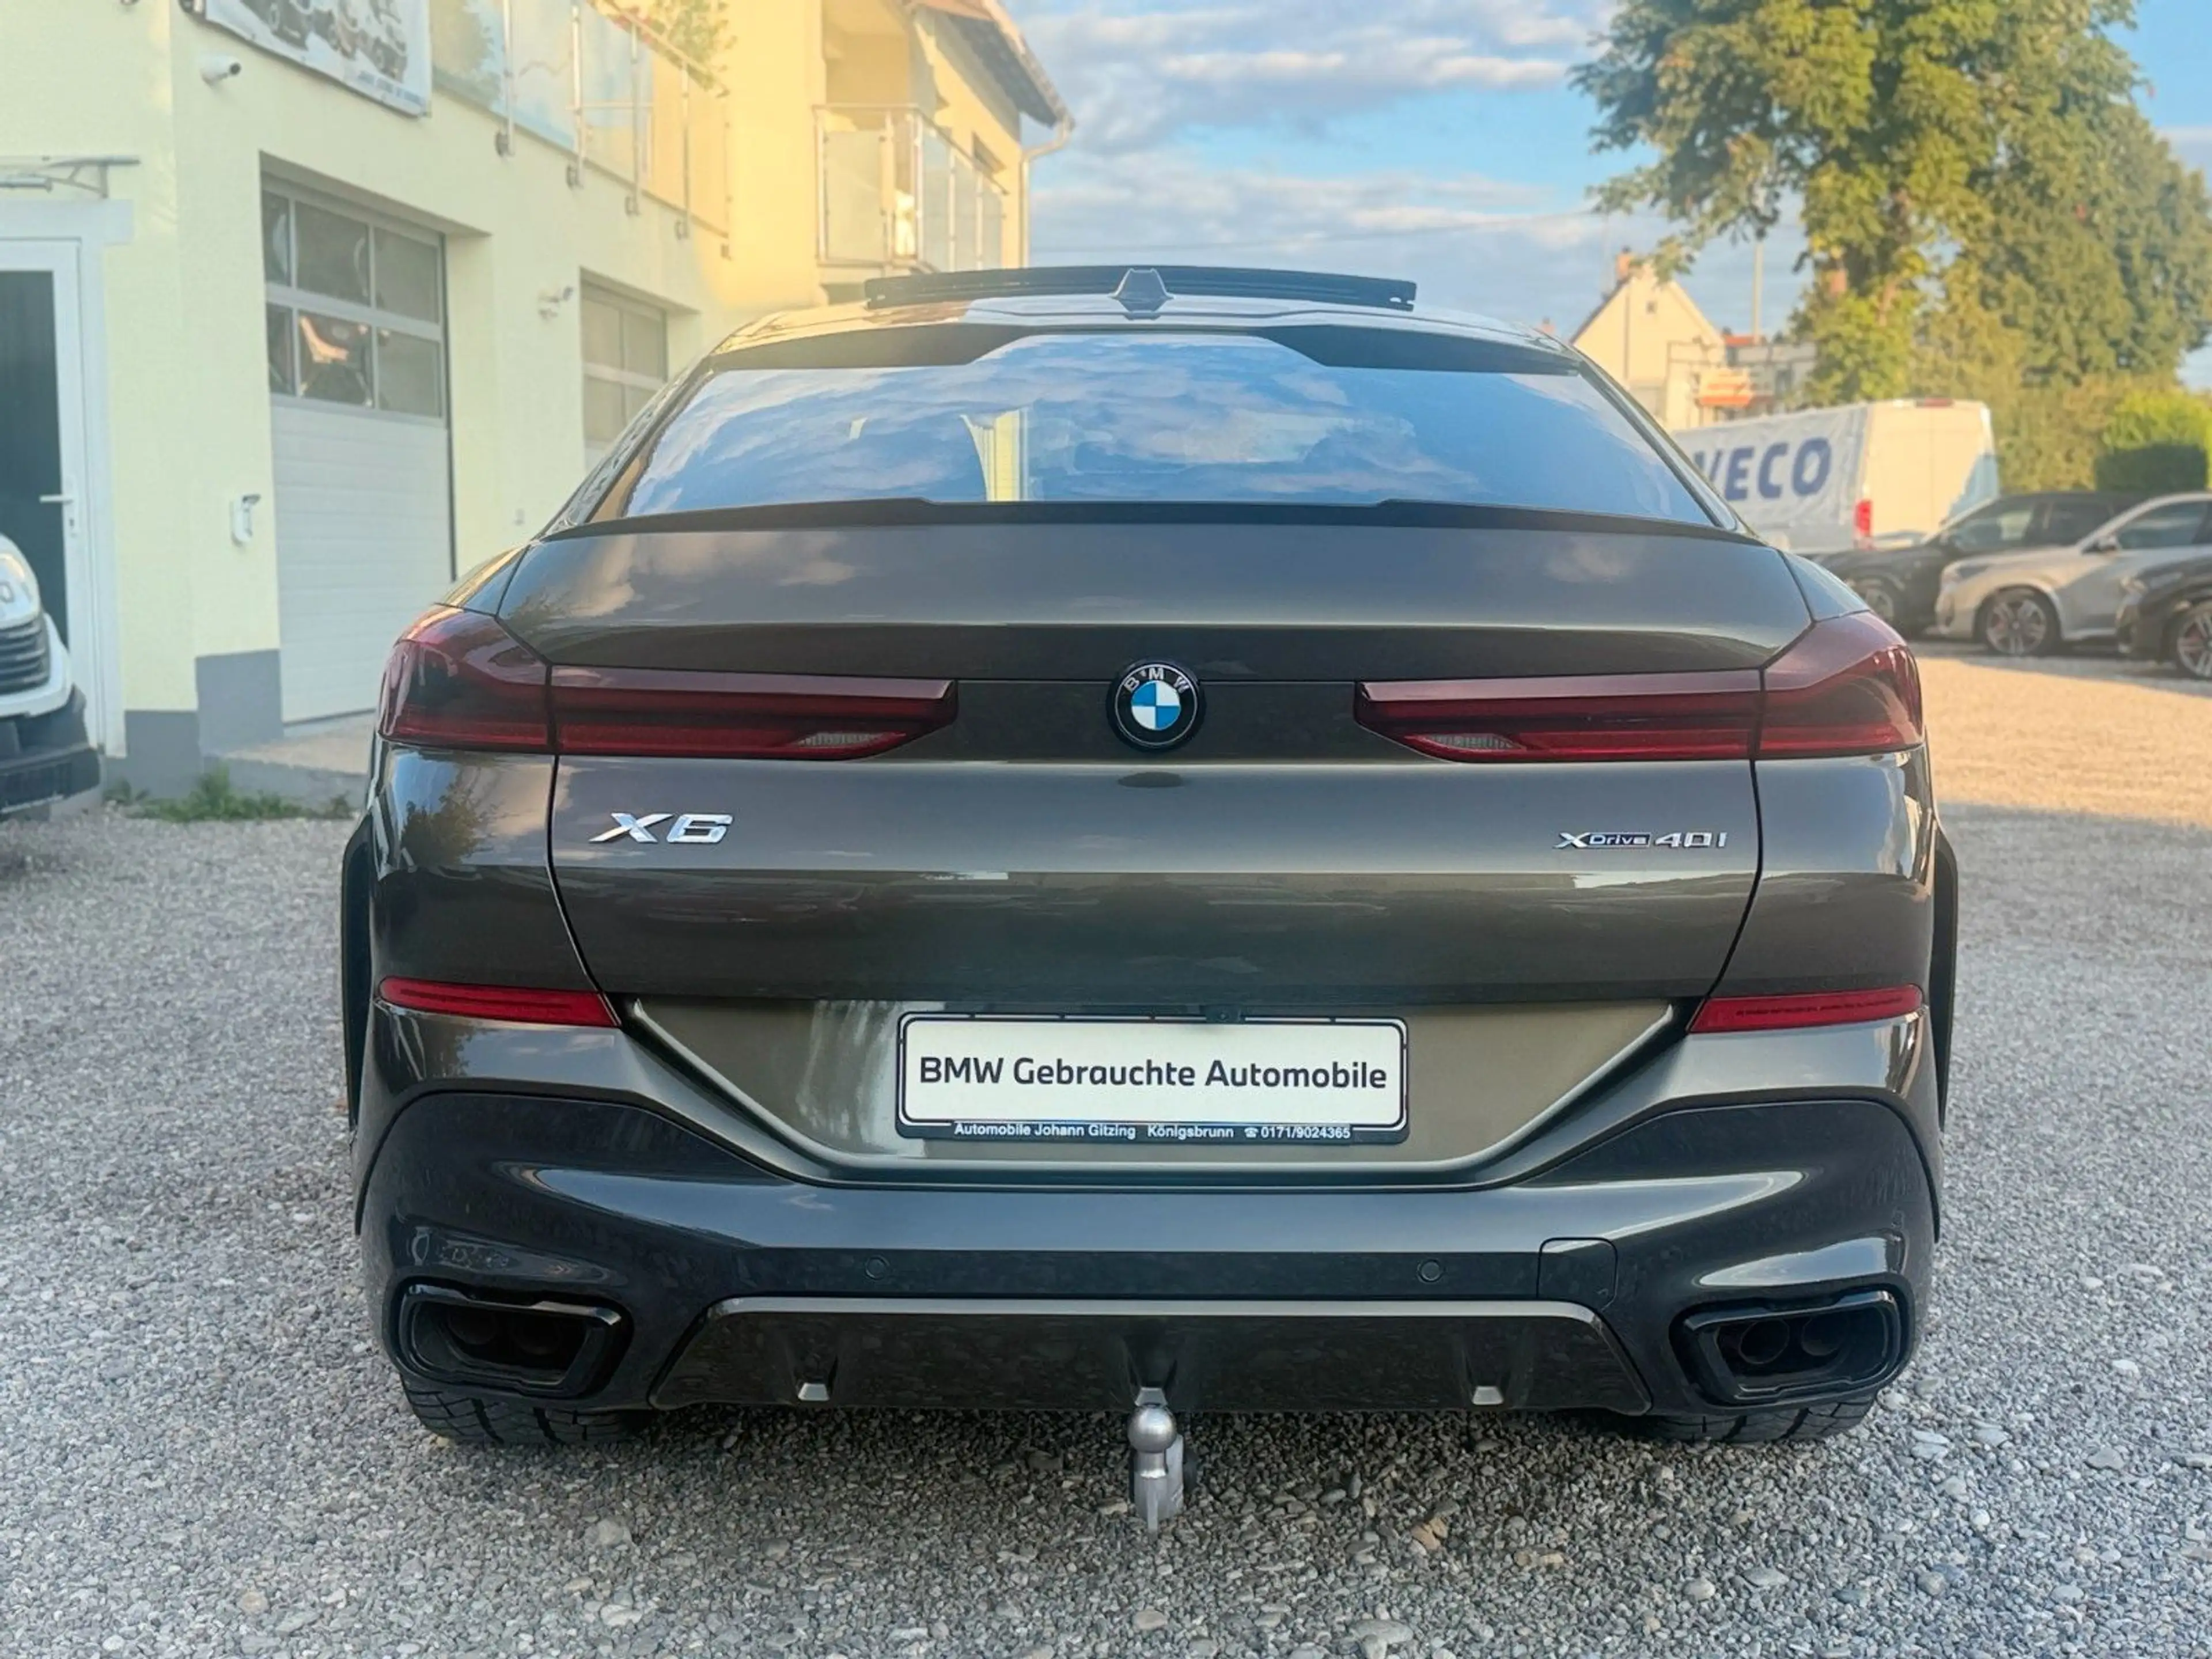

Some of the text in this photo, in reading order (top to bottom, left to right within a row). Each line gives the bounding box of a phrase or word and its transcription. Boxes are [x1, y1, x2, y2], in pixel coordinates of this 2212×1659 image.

[1124, 667, 1191, 694] BMW
[588, 812, 734, 844] X6
[920, 1056, 1387, 1089] BMW Gebrauchte Automobile
[954, 1123, 1351, 1140] Automobile Johann Gitzing Königsbrunn 0171/9024365
